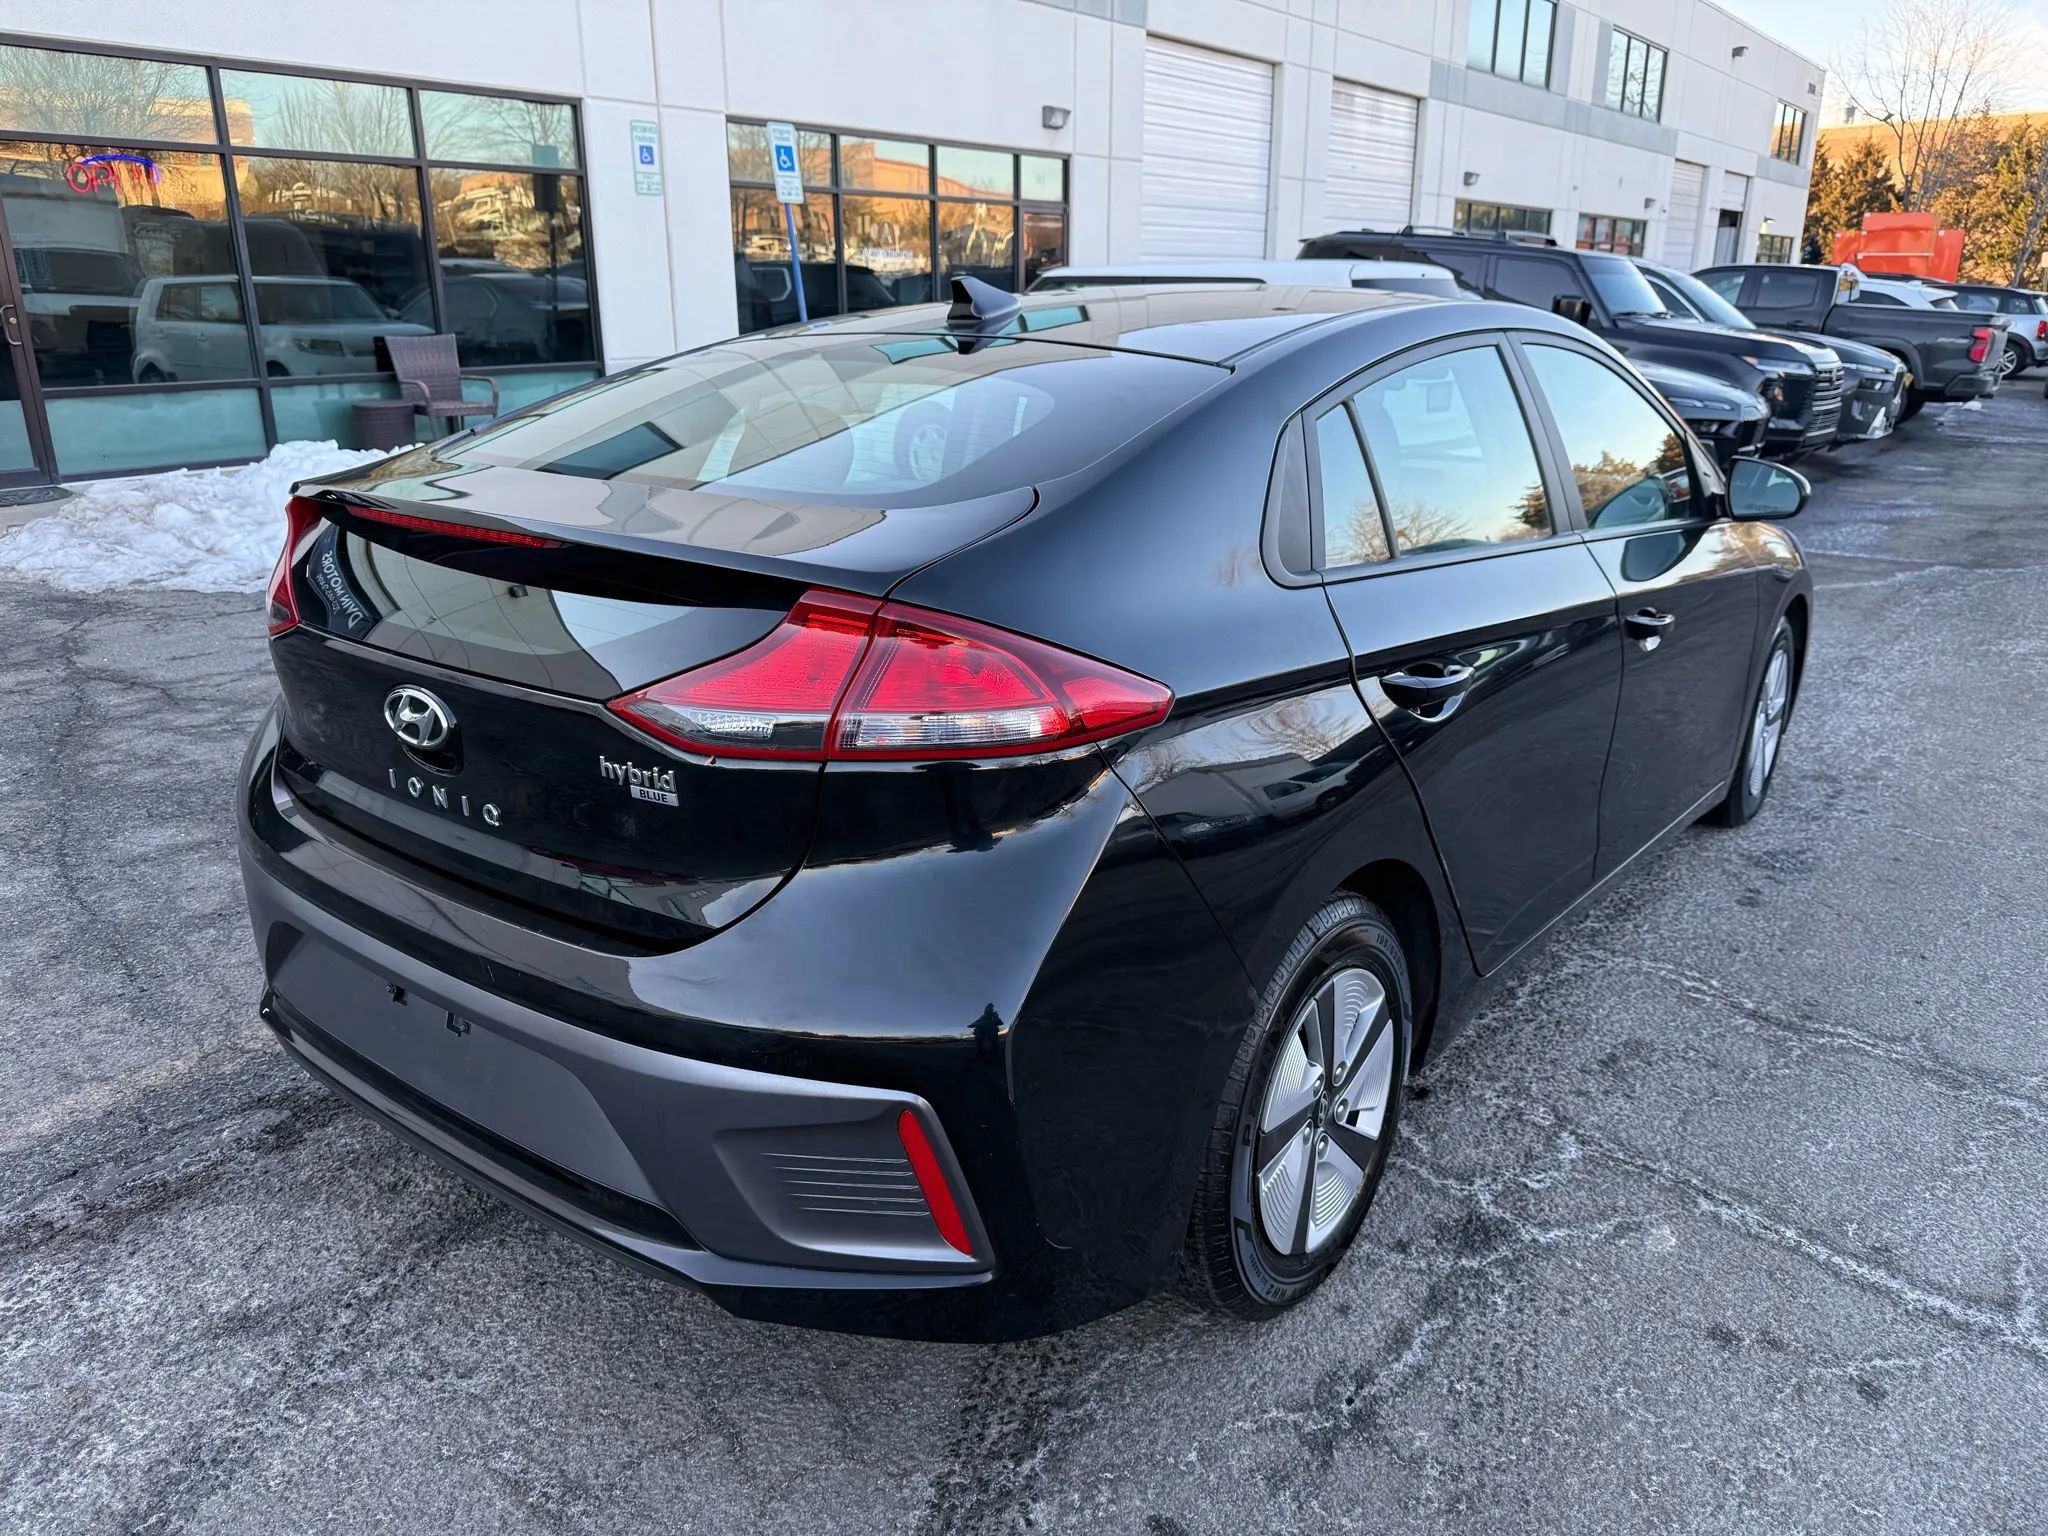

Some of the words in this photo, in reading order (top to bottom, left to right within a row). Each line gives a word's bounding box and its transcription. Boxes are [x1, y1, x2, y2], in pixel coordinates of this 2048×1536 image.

[66, 161, 158, 194] OPN
[599, 755, 676, 792] hybrid
[387, 767, 502, 827] IONIQ
[639, 789, 668, 803] BLUE
